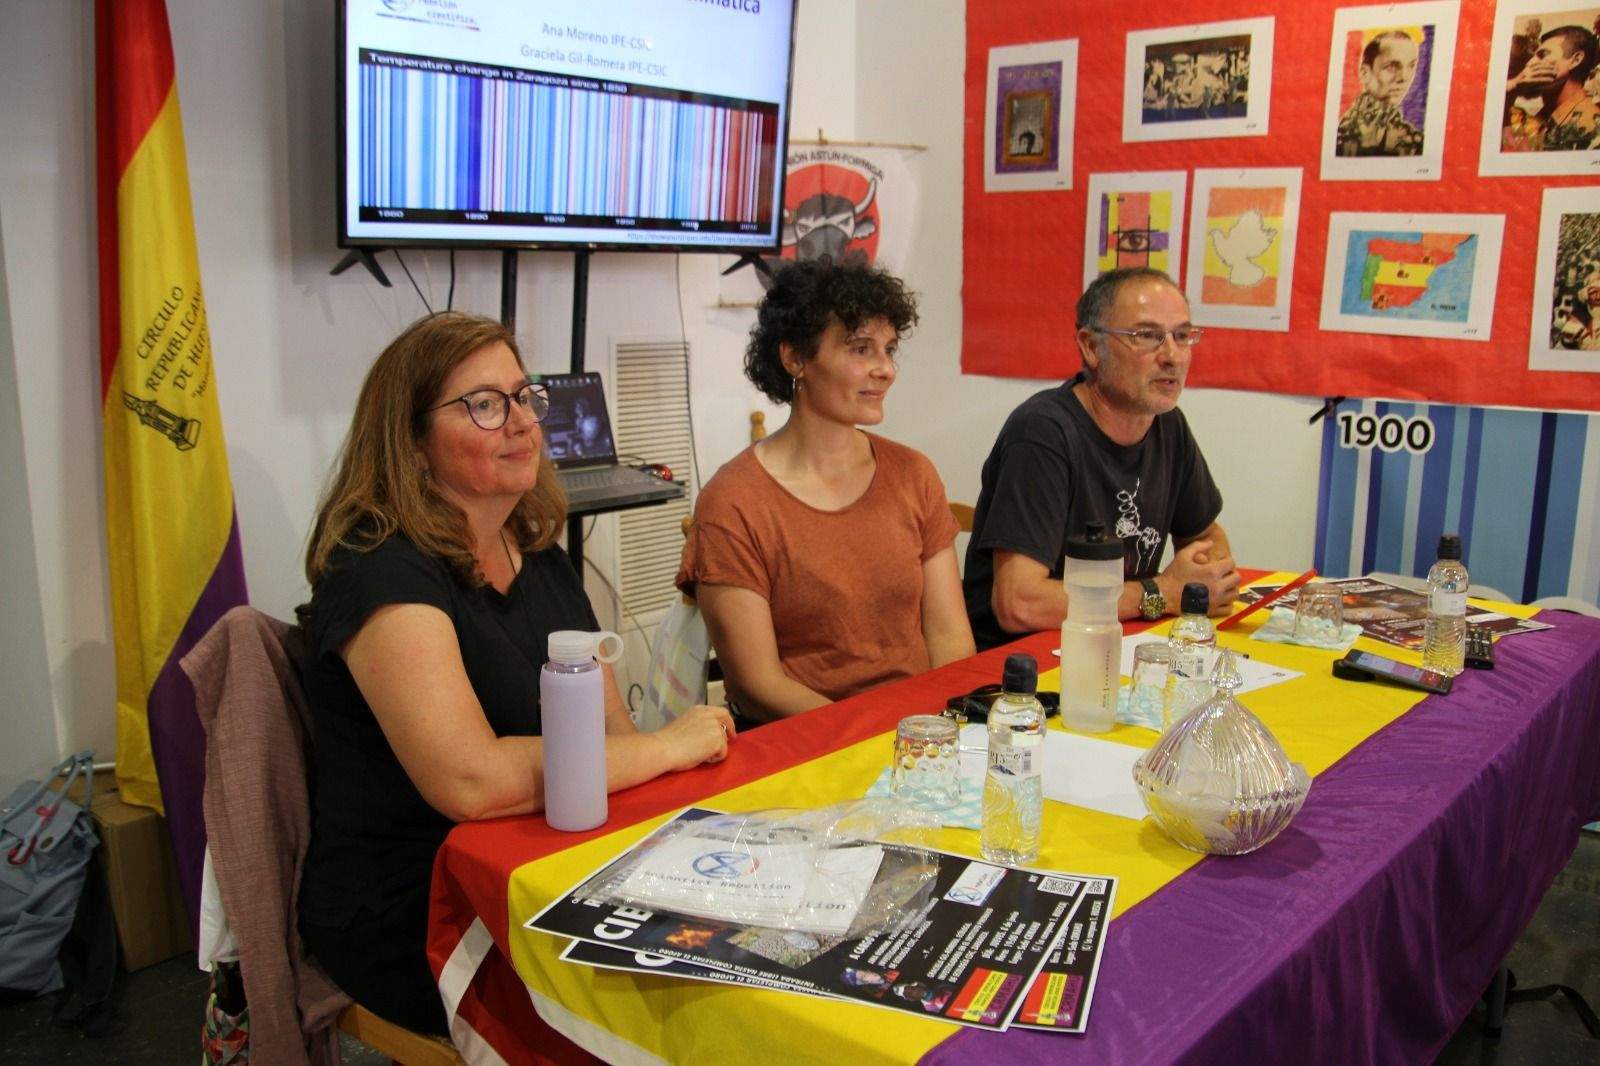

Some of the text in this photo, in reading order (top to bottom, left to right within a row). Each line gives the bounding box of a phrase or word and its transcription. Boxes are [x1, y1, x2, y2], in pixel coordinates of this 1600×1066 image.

[541, 21, 563, 38] Ana
[567, 27, 608, 44] Moreno
[368, 52, 452, 71] Temperature
[454, 64, 500, 78] change
[502, 69, 513, 79] in
[570, 79, 599, 89] since
[520, 44, 669, 77] Graciela Gil-Romera IPE-CSIC
[145, 281, 201, 393] REPUBLICAN
[173, 363, 194, 391] DE
[1339, 413, 1432, 452] 1900
